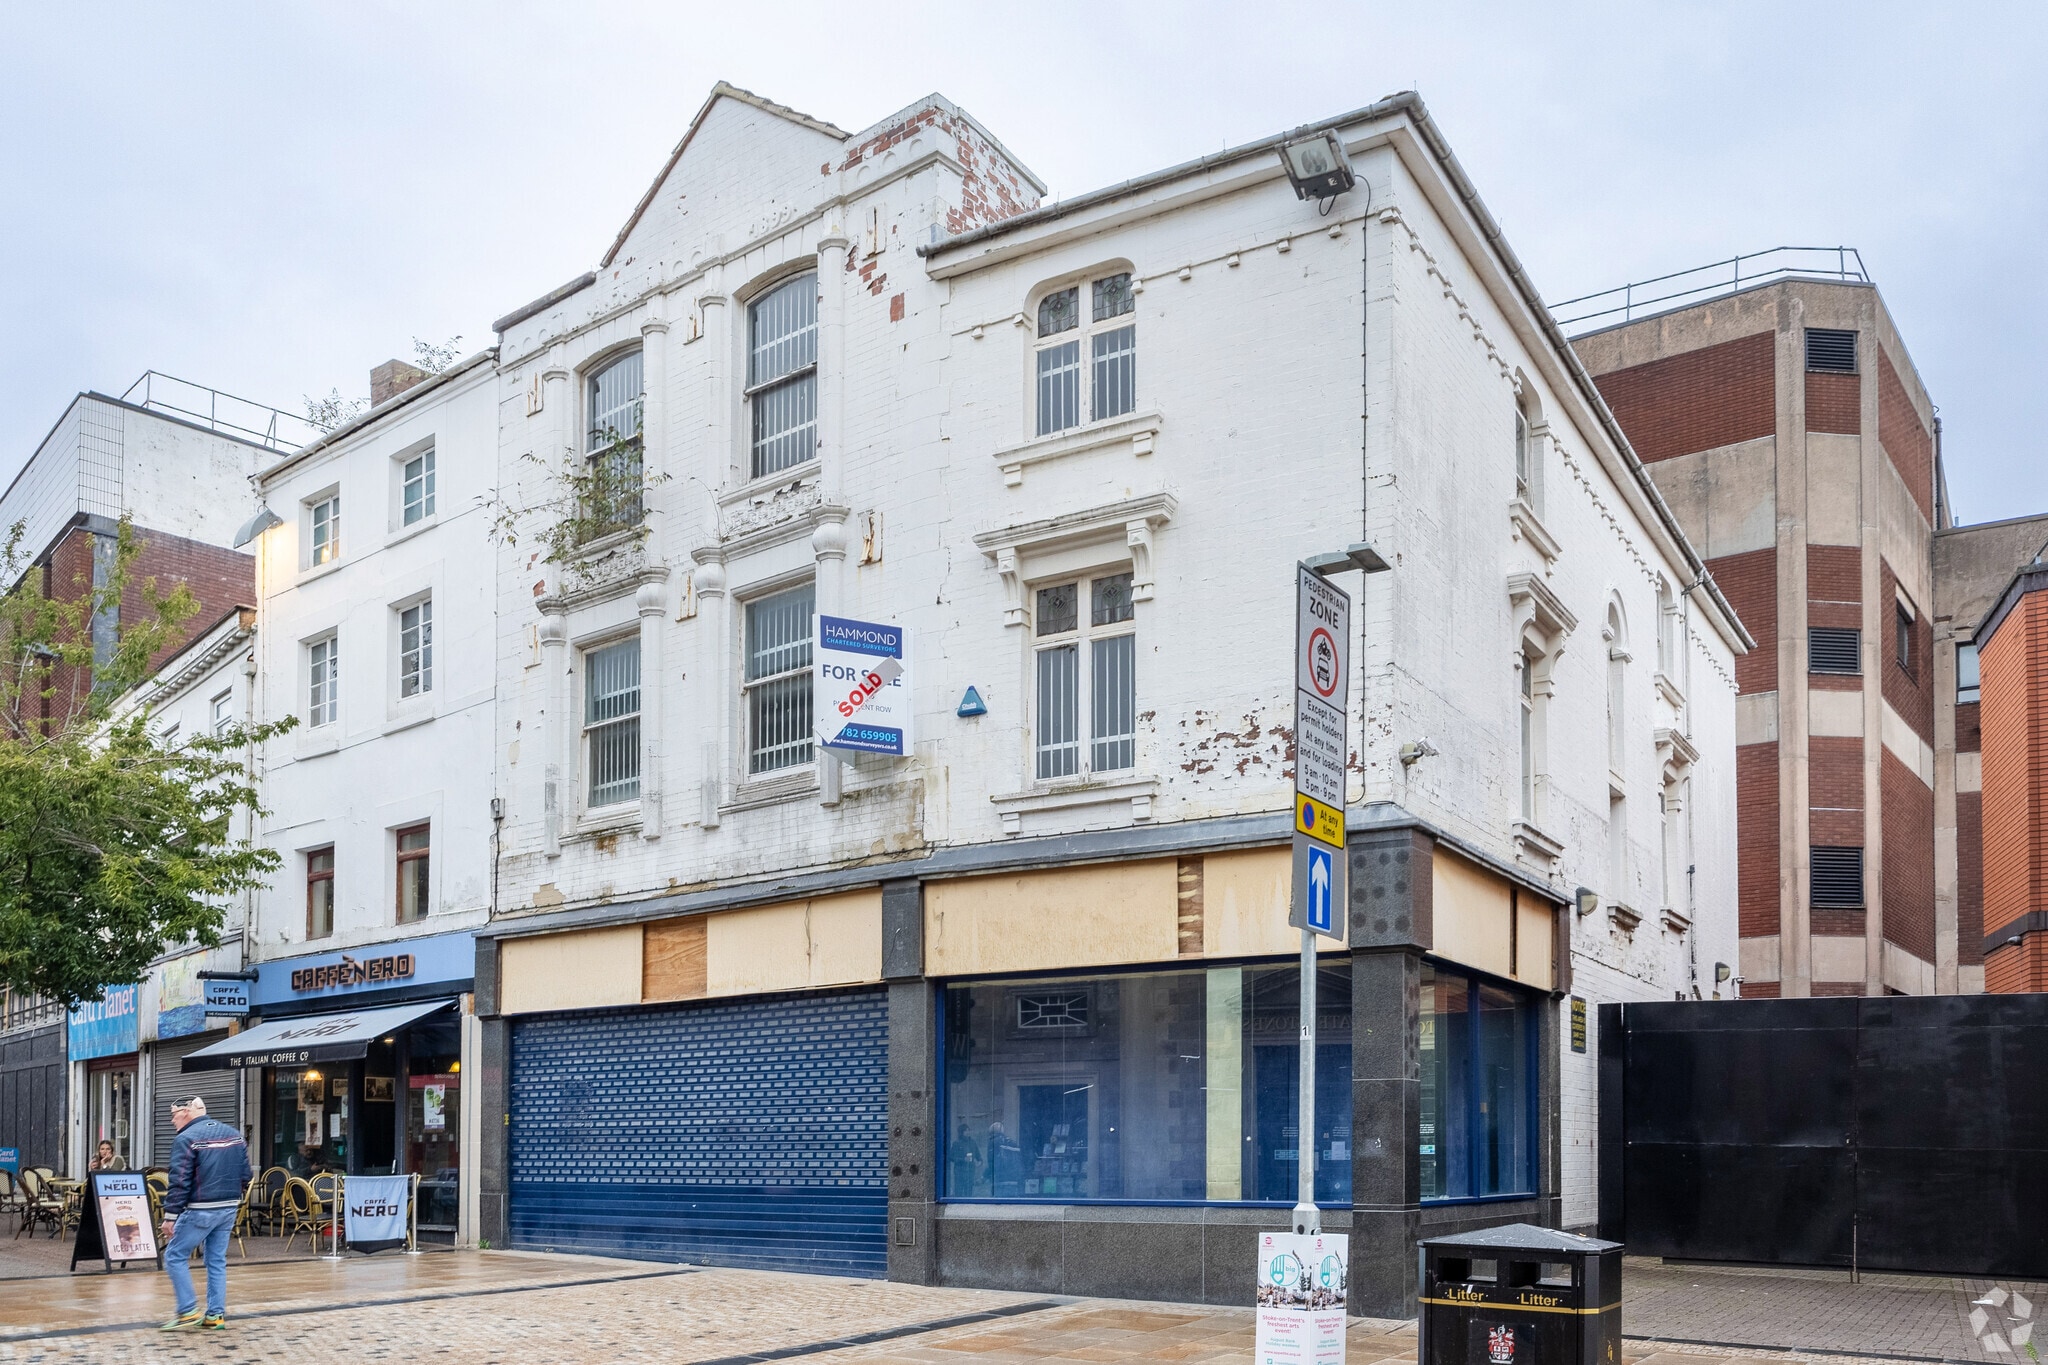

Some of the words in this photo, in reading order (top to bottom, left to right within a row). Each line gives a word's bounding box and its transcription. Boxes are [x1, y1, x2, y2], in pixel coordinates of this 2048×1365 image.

[1304, 576, 1345, 612] PEDESTRIAN
[1310, 596, 1339, 630] ZONE
[825, 624, 897, 646] HAMMOND
[826, 637, 861, 648] CHARTERED
[862, 643, 897, 653] SURVEYORS
[822, 663, 856, 682] FOR
[838, 672, 883, 718] SOLD
[875, 705, 892, 713] ROW
[1307, 699, 1328, 720] Except
[1329, 711, 1337, 725] for
[1301, 712, 1321, 730] permit
[1321, 720, 1343, 741] holders
[861, 730, 897, 743] 659905
[1306, 730, 1313, 742] At
[1314, 736, 1324, 750] any
[1325, 740, 1338, 756] time
[1300, 746, 1311, 759] and
[1312, 751, 1320, 763] for
[1322, 755, 1343, 777] loading
[1320, 809, 1328, 822] At
[1328, 815, 1339, 828] any
[1322, 825, 1335, 839] time
[206, 996, 247, 1006] NERO
[1302, 1026, 1307, 1037] 1
[230, 1057, 242, 1067] THE
[245, 1055, 269, 1066] ITALIAN
[271, 1052, 297, 1063] COFFEE
[104, 1183, 138, 1192] NERO
[351, 1205, 399, 1218] NERO
[131, 1243, 151, 1252] LATTE
[1285, 1265, 1296, 1273] big
[1448, 1287, 1485, 1302] Litter
[1520, 1292, 1558, 1307] Litter
[1262, 1314, 1305, 1324] Stoke-on-Trent's
